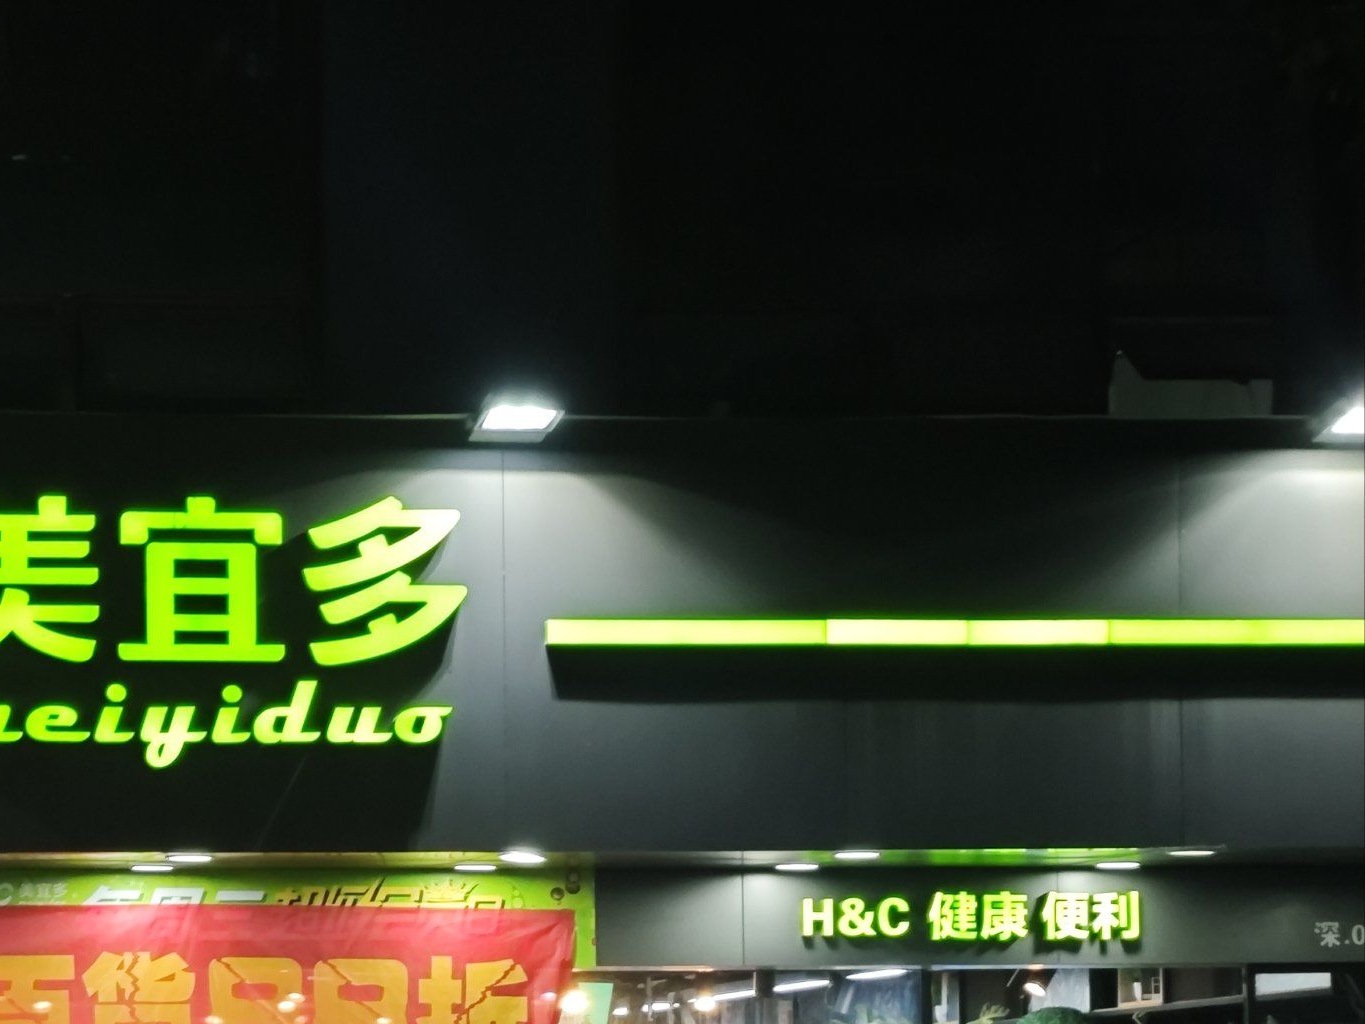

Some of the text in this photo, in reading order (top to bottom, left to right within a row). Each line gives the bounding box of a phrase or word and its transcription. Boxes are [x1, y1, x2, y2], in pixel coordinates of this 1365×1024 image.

[800, 889, 1141, 942] H&C 健康 便利
